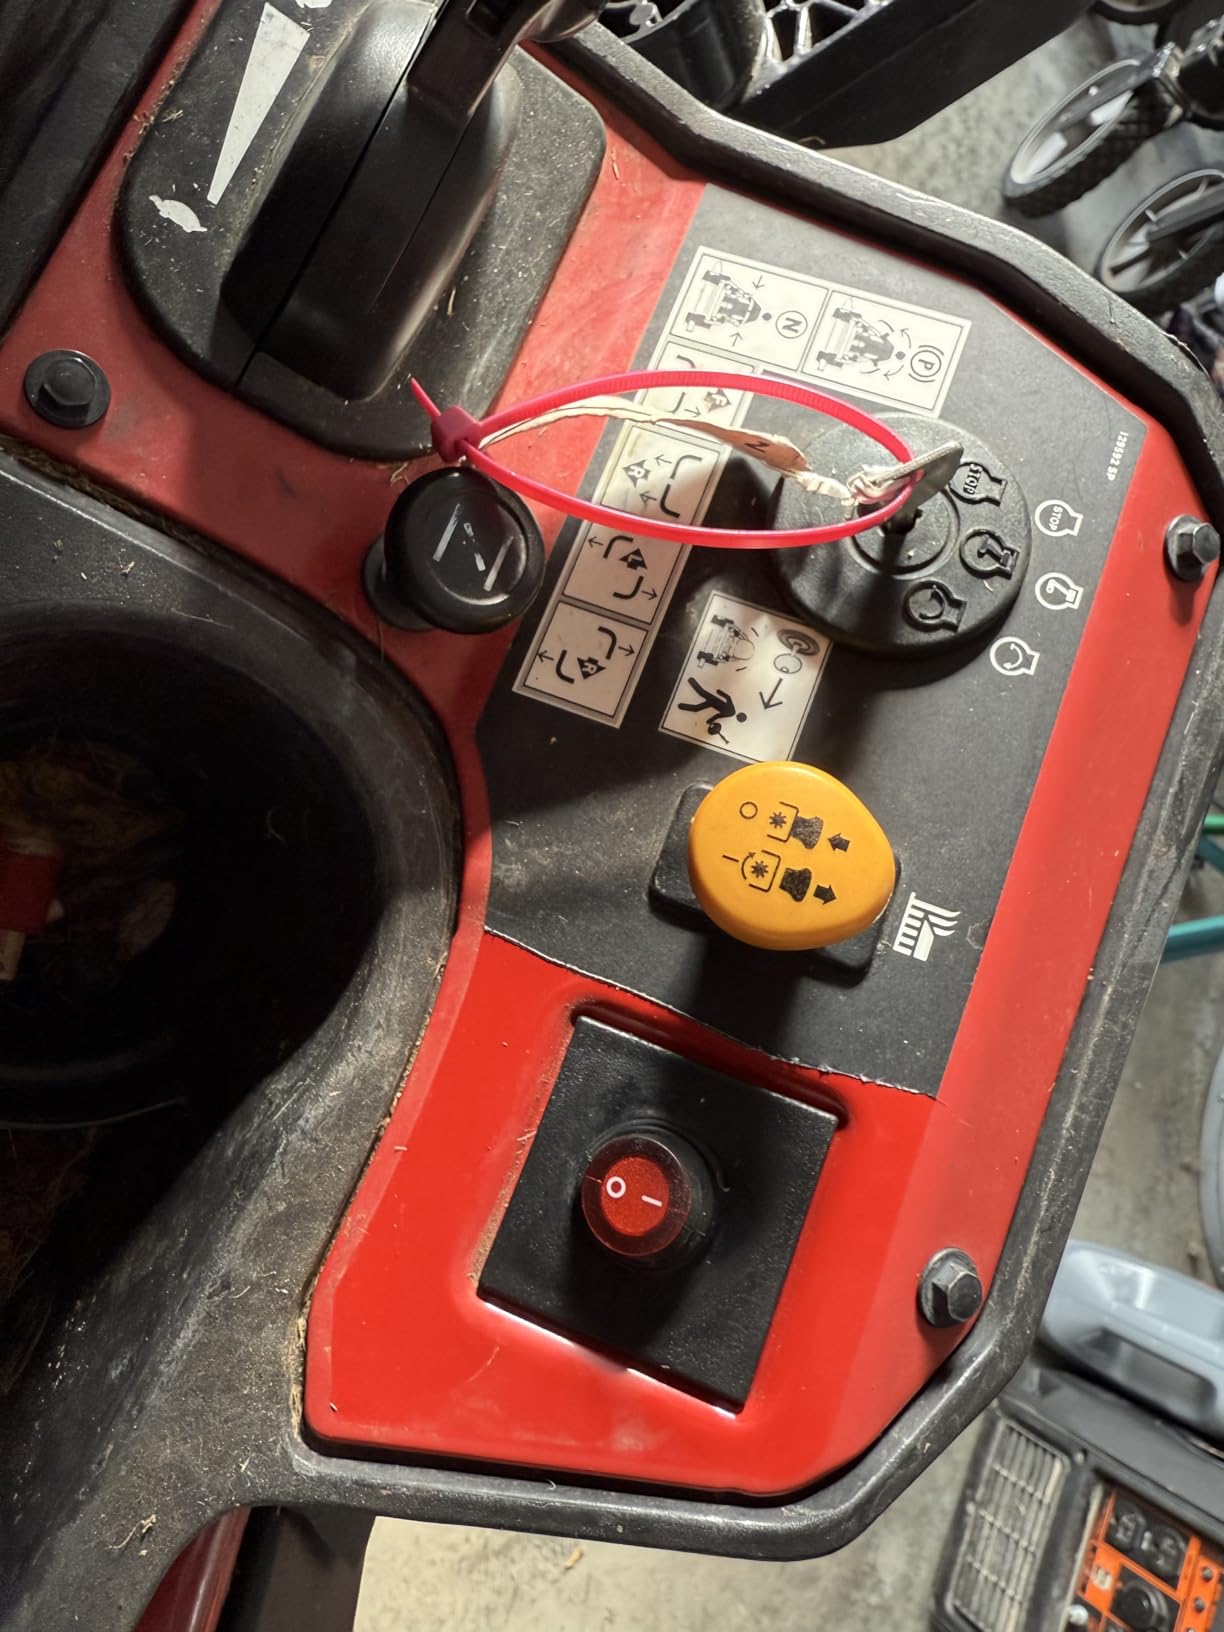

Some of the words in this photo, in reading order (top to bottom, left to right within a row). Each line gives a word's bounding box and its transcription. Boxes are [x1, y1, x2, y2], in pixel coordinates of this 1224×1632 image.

[781, 316, 803, 335] N
[917, 358, 936, 371] P
[963, 463, 984, 495] STOP
[1049, 505, 1064, 532] STOP
